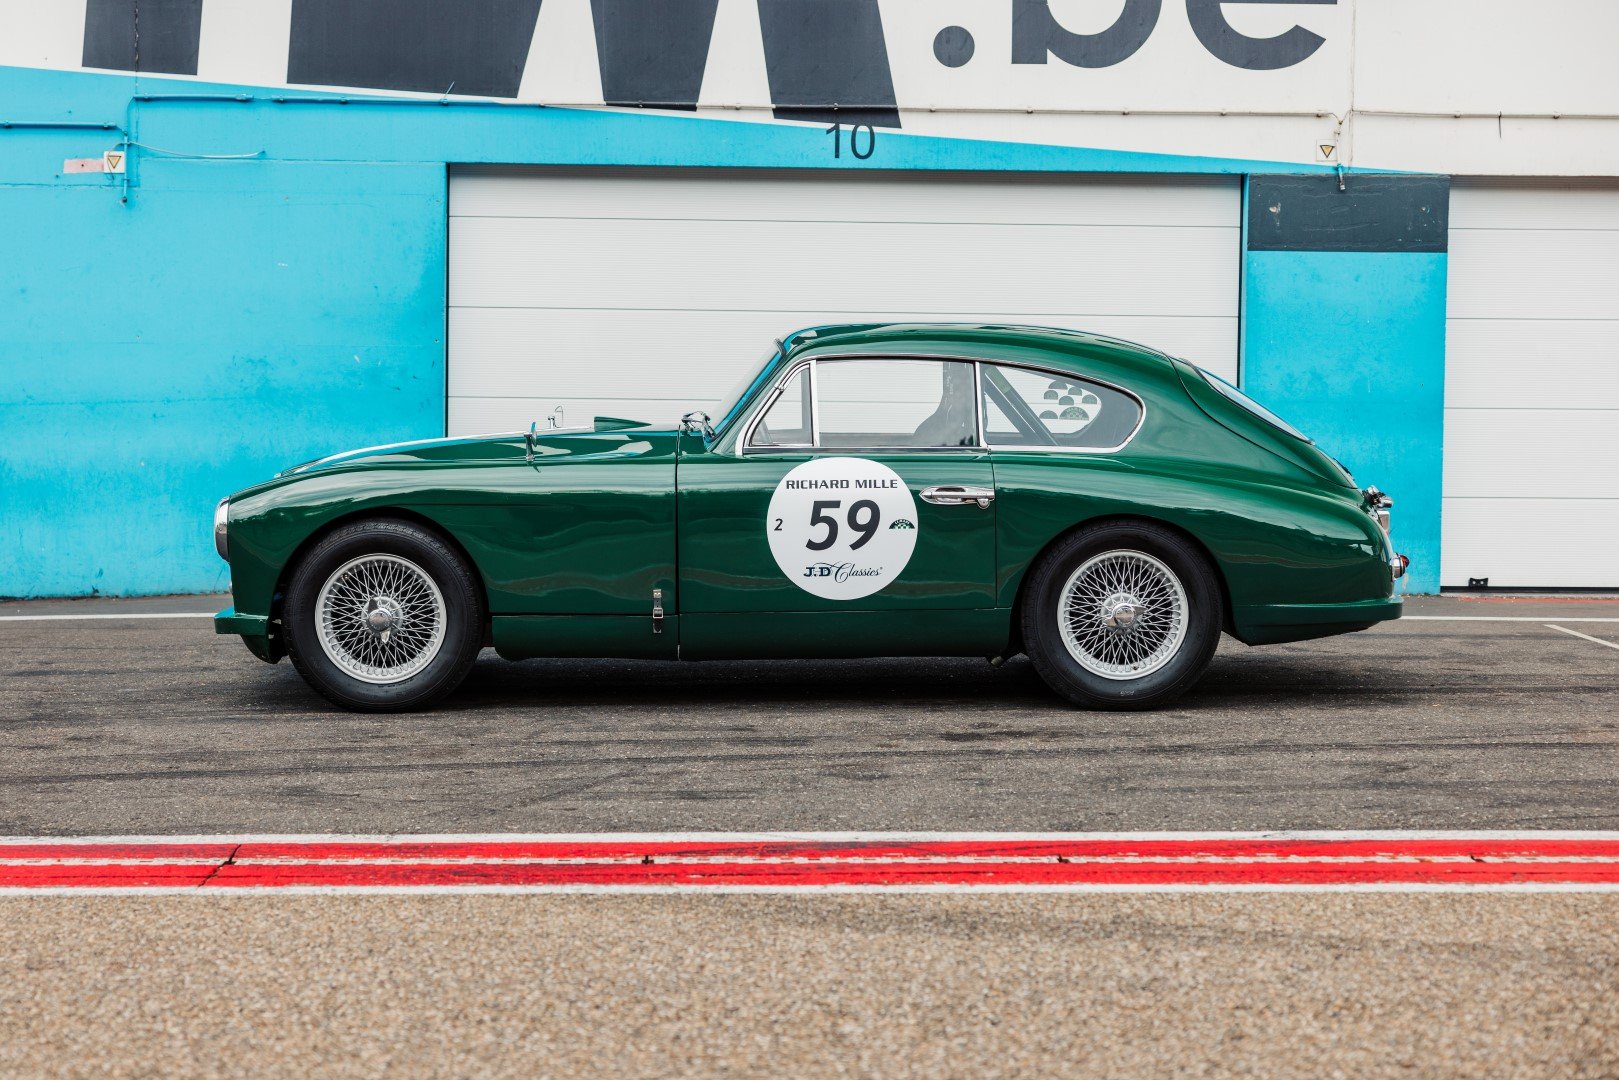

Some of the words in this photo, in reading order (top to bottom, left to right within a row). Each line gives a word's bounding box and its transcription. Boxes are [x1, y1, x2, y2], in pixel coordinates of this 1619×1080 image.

[826, 122, 876, 160] 10
[786, 479, 850, 490] RICHARD
[855, 479, 898, 489] MILLE
[774, 518, 784, 531] 2
[805, 499, 881, 551] 59
